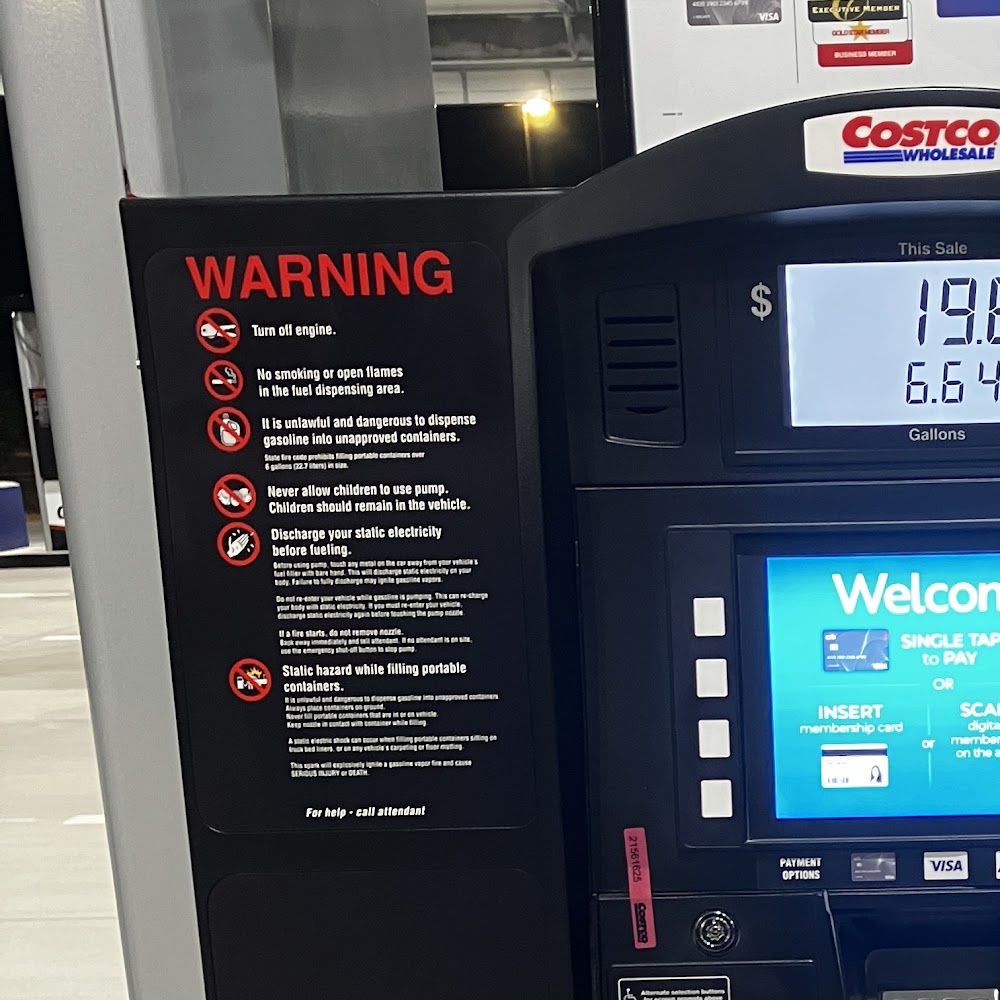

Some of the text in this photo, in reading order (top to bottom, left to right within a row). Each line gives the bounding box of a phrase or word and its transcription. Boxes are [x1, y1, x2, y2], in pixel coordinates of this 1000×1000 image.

[862, 2, 899, 14] MEMBER
[757, 12, 779, 21] VISA
[842, 115, 1000, 149] COSTCO
[900, 147, 996, 164] WHOLESALE
[898, 242, 967, 255] This Sale
[186, 250, 452, 299] WARNING
[751, 282, 772, 321] $
[252, 323, 336, 338] Turn off engine.
[257, 366, 403, 381] No smoking or open flames
[259, 383, 404, 397] in the fuel dispensing area.
[262, 414, 476, 429] It is unlawful and dangerous to dispense
[264, 430, 460, 448] gasoline into unapproved containers.
[909, 428, 965, 441] Gallons
[268, 484, 448, 497] Never allow children to use pump.
[900, 633, 963, 649] SINGLE
[922, 652, 977, 665] to PAY
[932, 678, 954, 690] OR
[818, 704, 884, 720] INSERT
[800, 722, 903, 735] membership card
[921, 738, 935, 749] or
[956, 749, 972, 759] on
[973, 747, 992, 758] the
[306, 808, 322, 817] For
[325, 807, 346, 819] help
[356, 807, 375, 817] call
[377, 806, 425, 816] attendant
[780, 858, 821, 867] PAYMENT
[930, 860, 962, 871] VISA
[782, 870, 820, 880] OPTIONS
